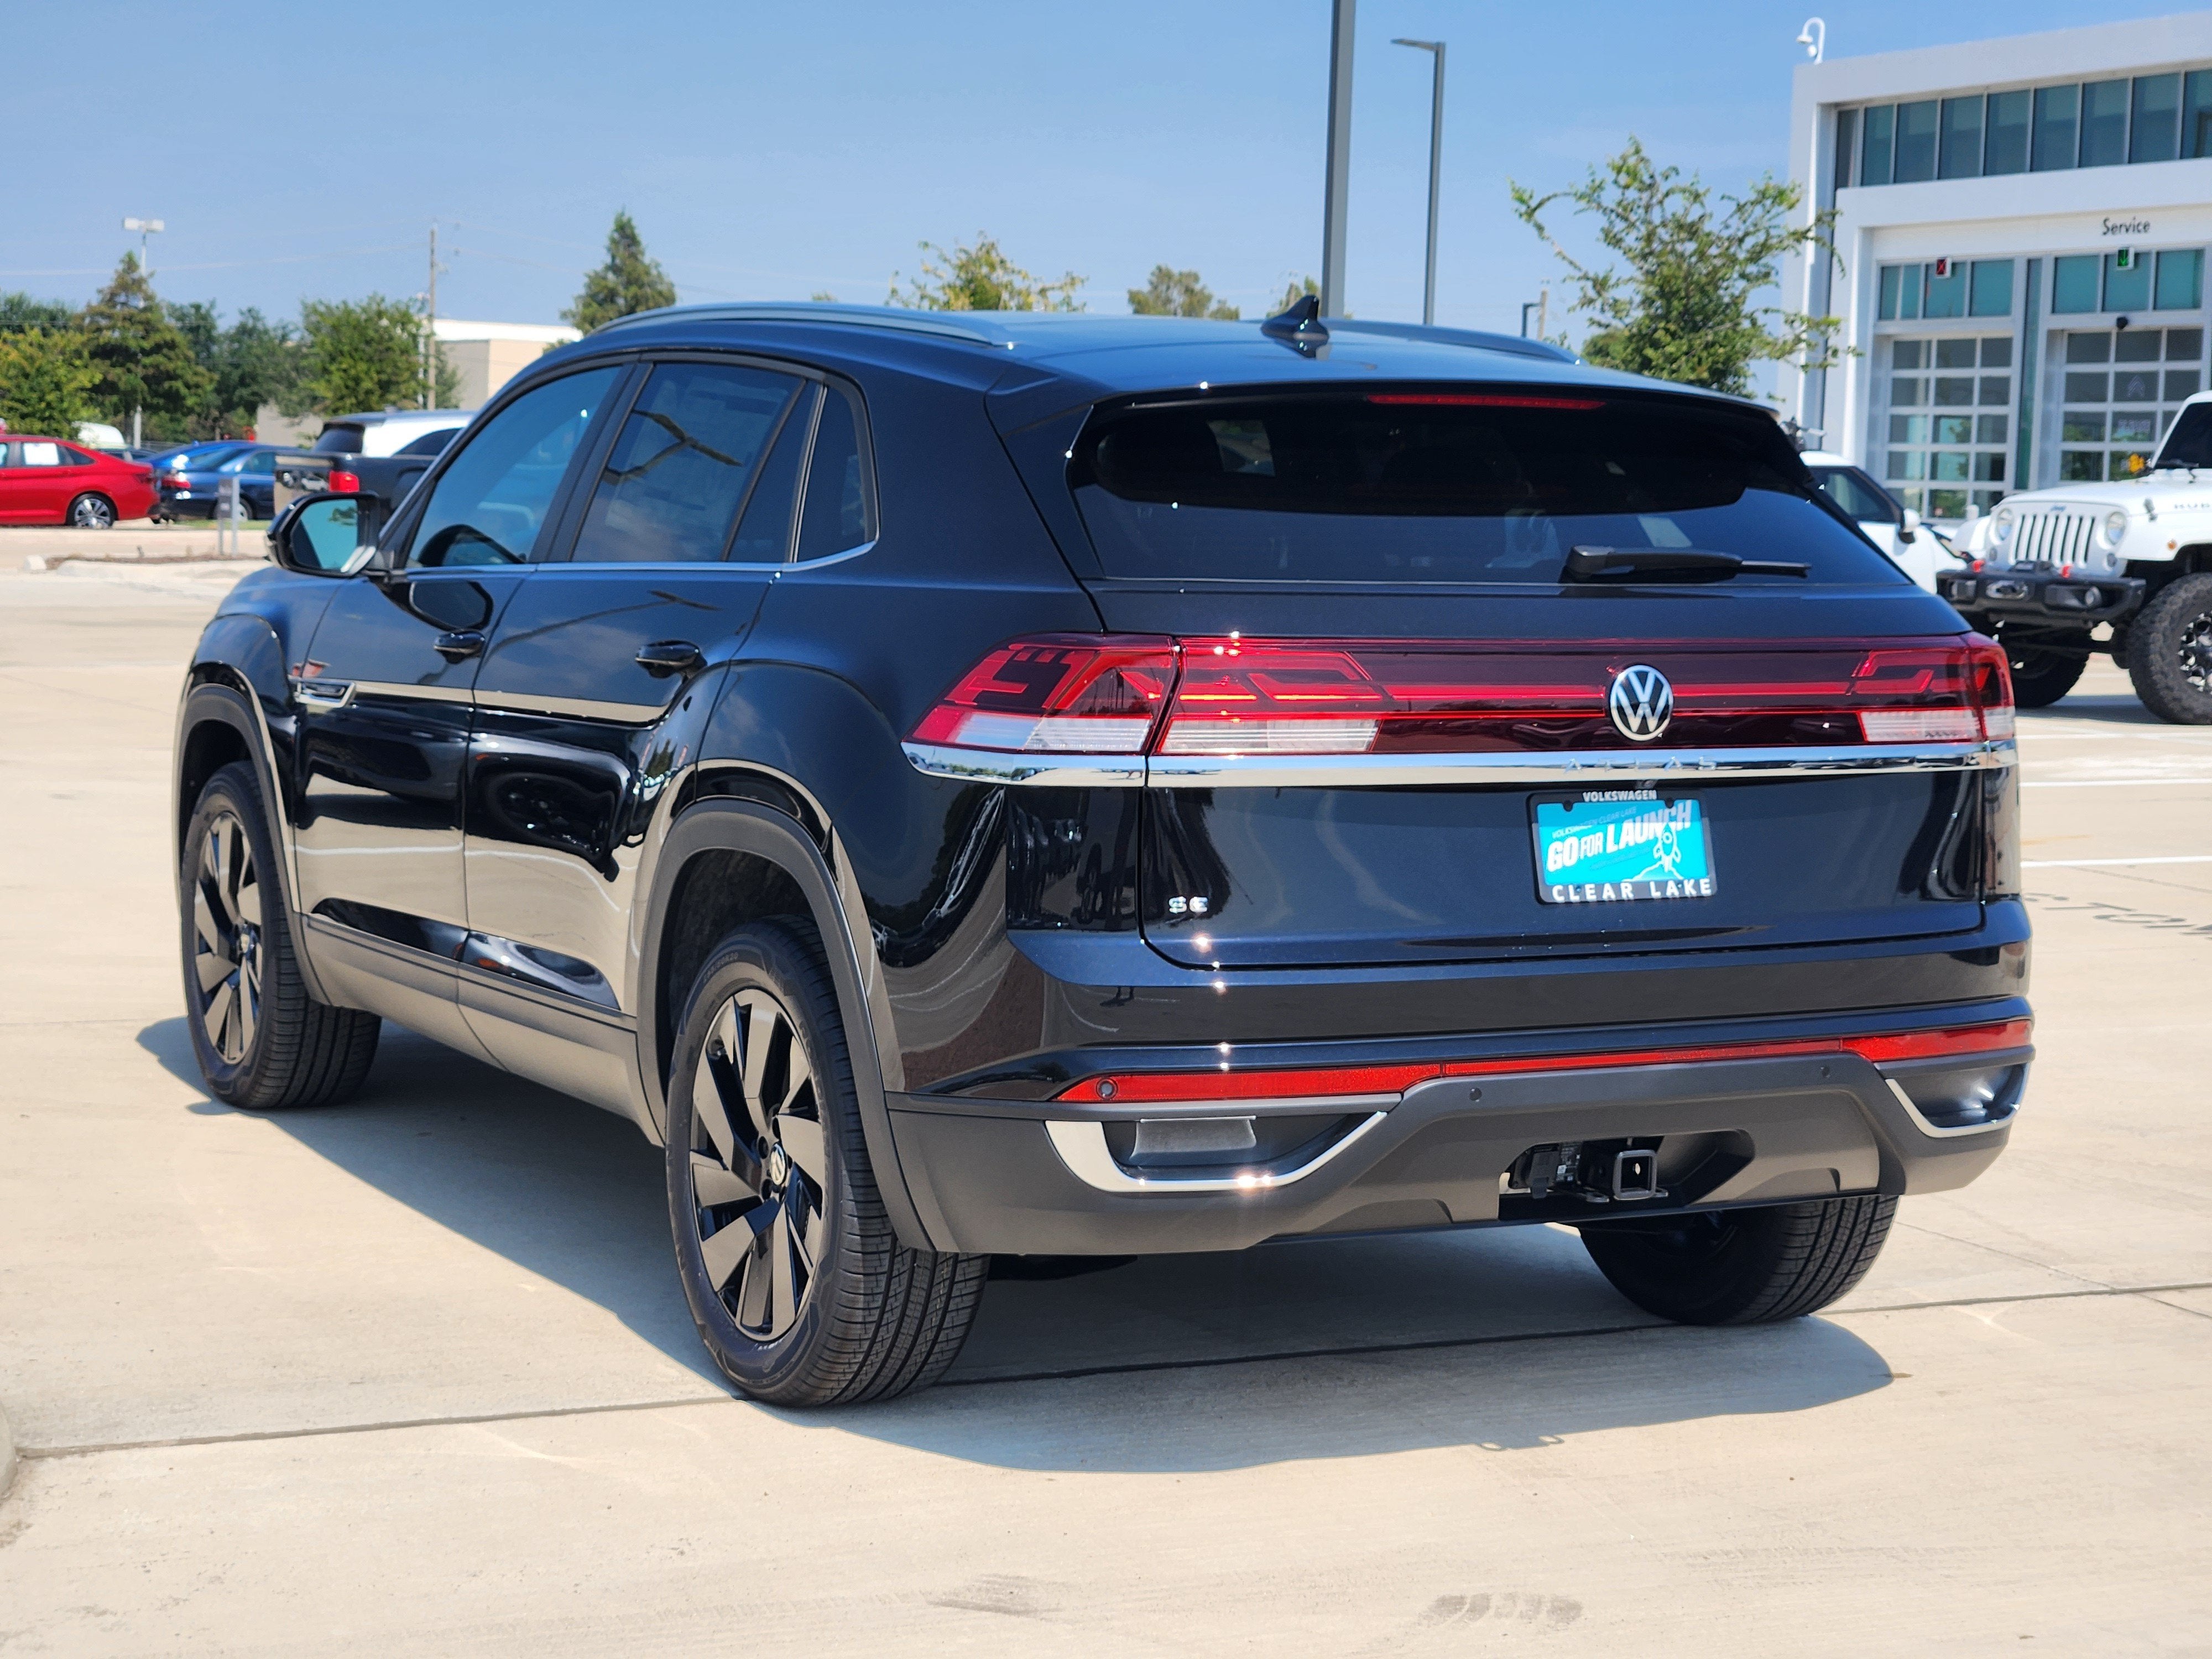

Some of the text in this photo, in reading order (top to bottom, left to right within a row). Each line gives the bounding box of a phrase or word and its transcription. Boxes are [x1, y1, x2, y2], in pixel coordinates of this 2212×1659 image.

[2103, 216, 2151, 236] Service
[1563, 756, 1717, 774] ATLAS
[1582, 790, 1657, 802] VOLKSWAGEN
[1547, 836, 1578, 873] GO
[1579, 832, 1603, 860] FOR
[1606, 800, 1692, 854] LAUNCH
[1552, 878, 1712, 904] CLEAR LAKE
